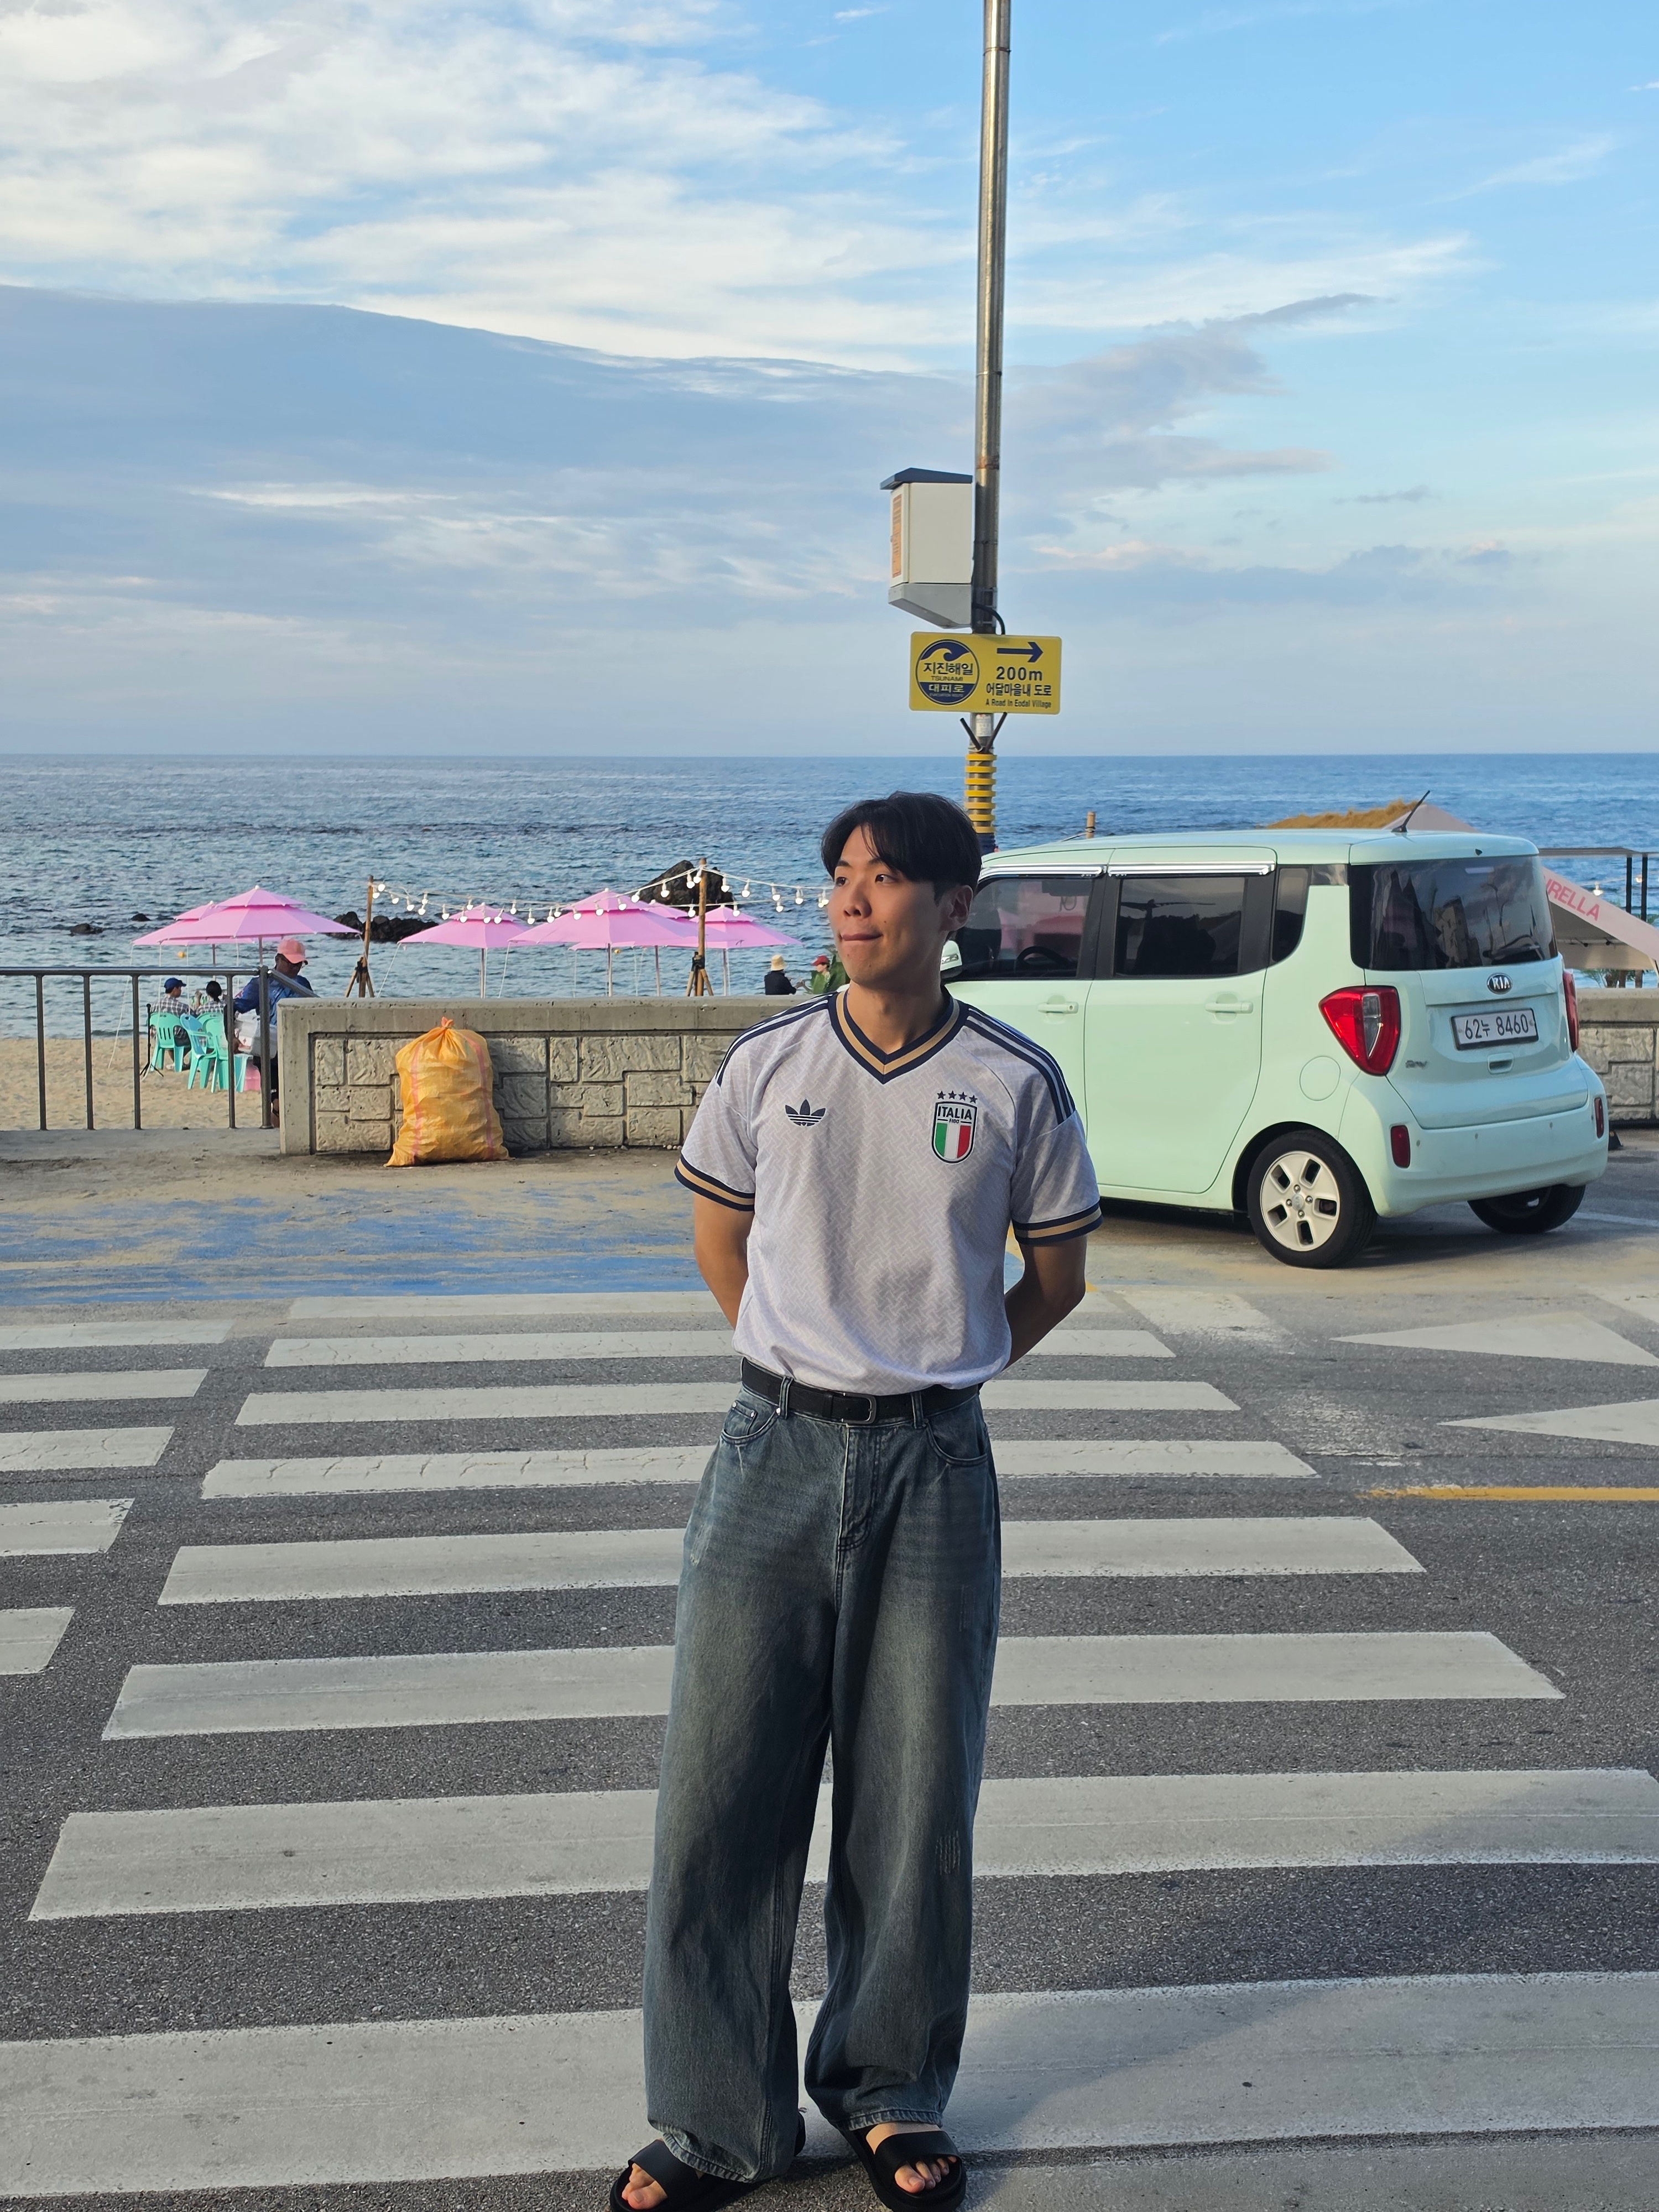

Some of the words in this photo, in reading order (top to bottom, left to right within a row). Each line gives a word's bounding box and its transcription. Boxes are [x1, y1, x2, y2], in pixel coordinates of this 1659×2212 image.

[923, 662, 973, 675] 지진해일
[996, 666, 1042, 681] 200m
[928, 684, 964, 693] 대피로
[986, 682, 1031, 697] 어달마을내
[1034, 685, 1052, 696] 도로
[1032, 700, 1052, 708] Village
[1465, 1019, 1490, 1040] 62누
[1496, 1014, 1529, 1036] 8460
[938, 1106, 972, 1120] ITALIA
